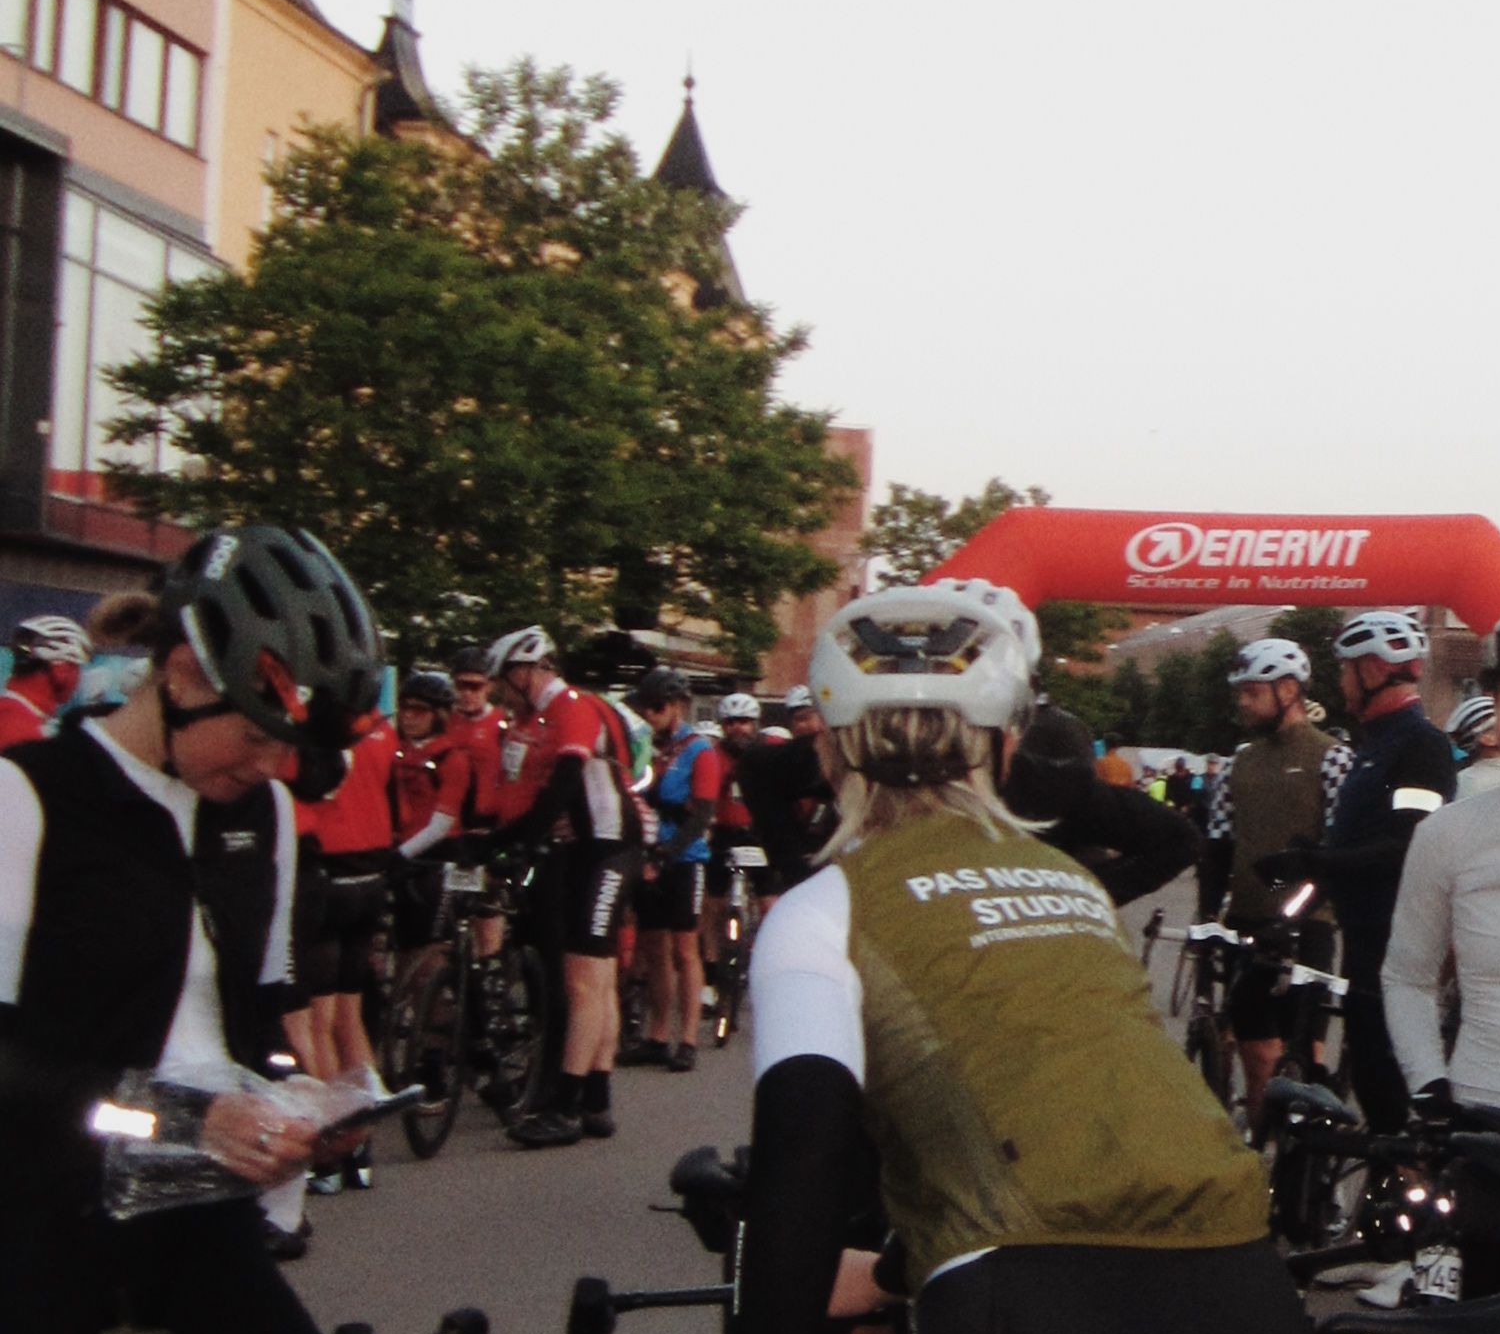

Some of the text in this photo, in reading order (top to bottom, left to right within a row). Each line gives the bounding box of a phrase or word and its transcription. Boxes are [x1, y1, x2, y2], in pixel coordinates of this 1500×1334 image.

[1197, 528, 1372, 567] ENERVIT
[1126, 573, 1369, 590] Science in Nutrition
[906, 868, 987, 901] PAS
